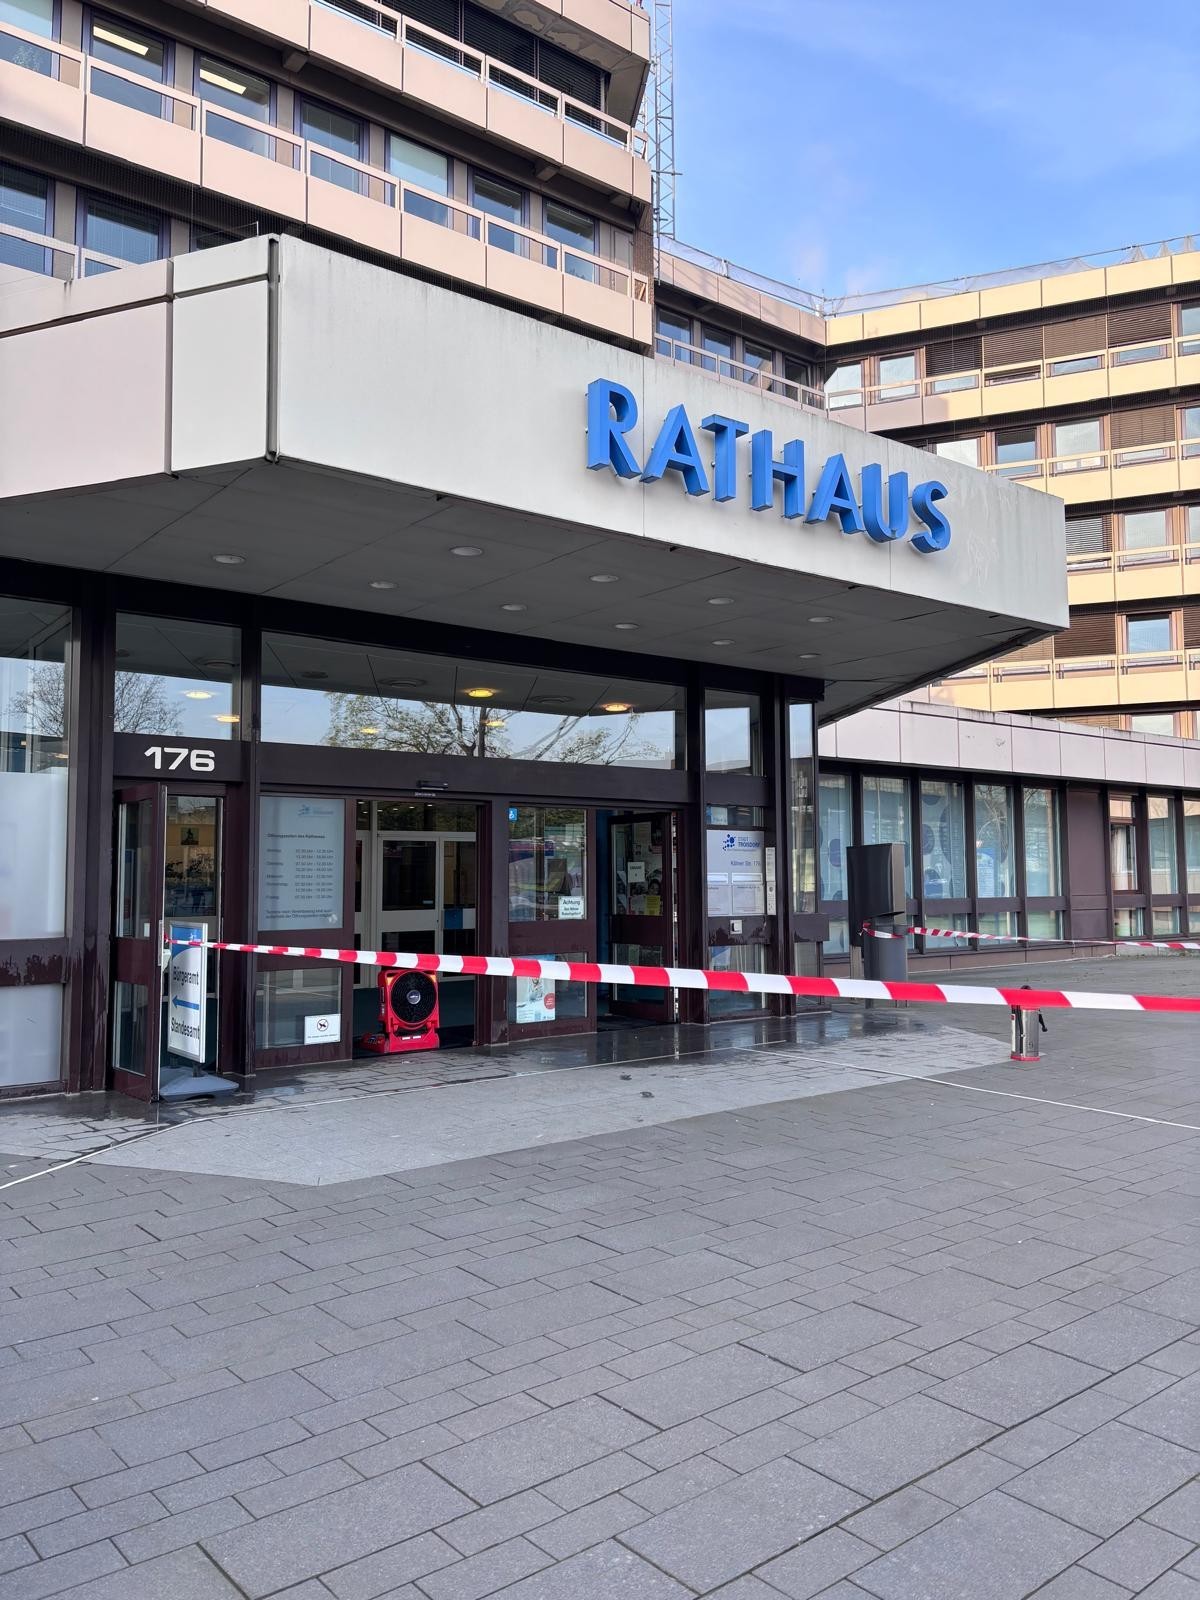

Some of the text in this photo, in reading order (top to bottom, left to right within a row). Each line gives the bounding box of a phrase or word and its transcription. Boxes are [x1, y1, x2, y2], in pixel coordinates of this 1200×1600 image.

[586, 377, 951, 553] RATHAUS
[144, 746, 215, 772] 176
[173, 965, 199, 986] Bürgeramt
[171, 1017, 200, 1039] Standesamt
